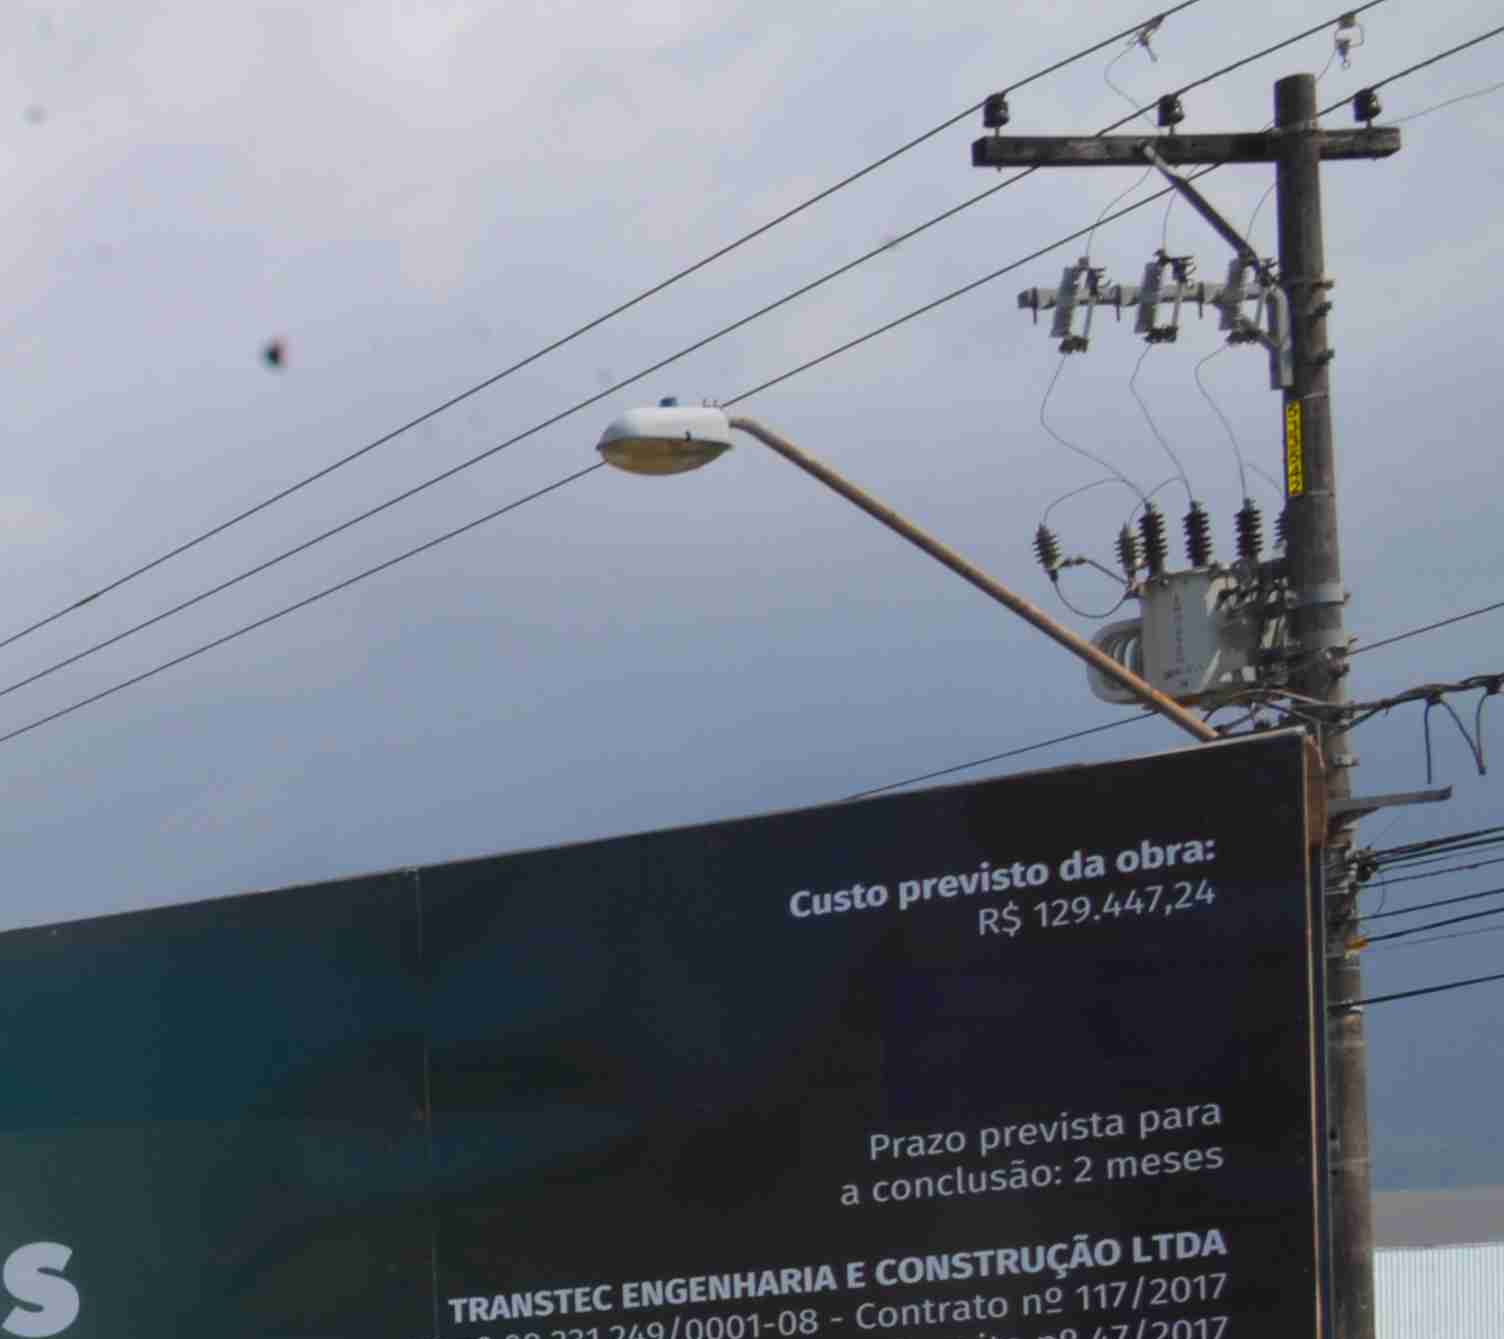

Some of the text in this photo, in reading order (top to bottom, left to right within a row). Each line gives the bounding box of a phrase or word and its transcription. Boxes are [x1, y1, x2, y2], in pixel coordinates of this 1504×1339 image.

[788, 839, 1216, 919] Custo previsto da obra:
[978, 878, 1216, 938] R$ 129.447,24
[869, 1102, 1222, 1162] Prazo prevista para
[840, 1146, 1224, 1207] a conclusão: 2 meses
[446, 1228, 1228, 1325] TRANSTEC ENGENHARIA E CONSTRUÇÃO LTDA
[855, 1294, 1009, 1330] Contrato
[1075, 1272, 1227, 1311] 117/2017
